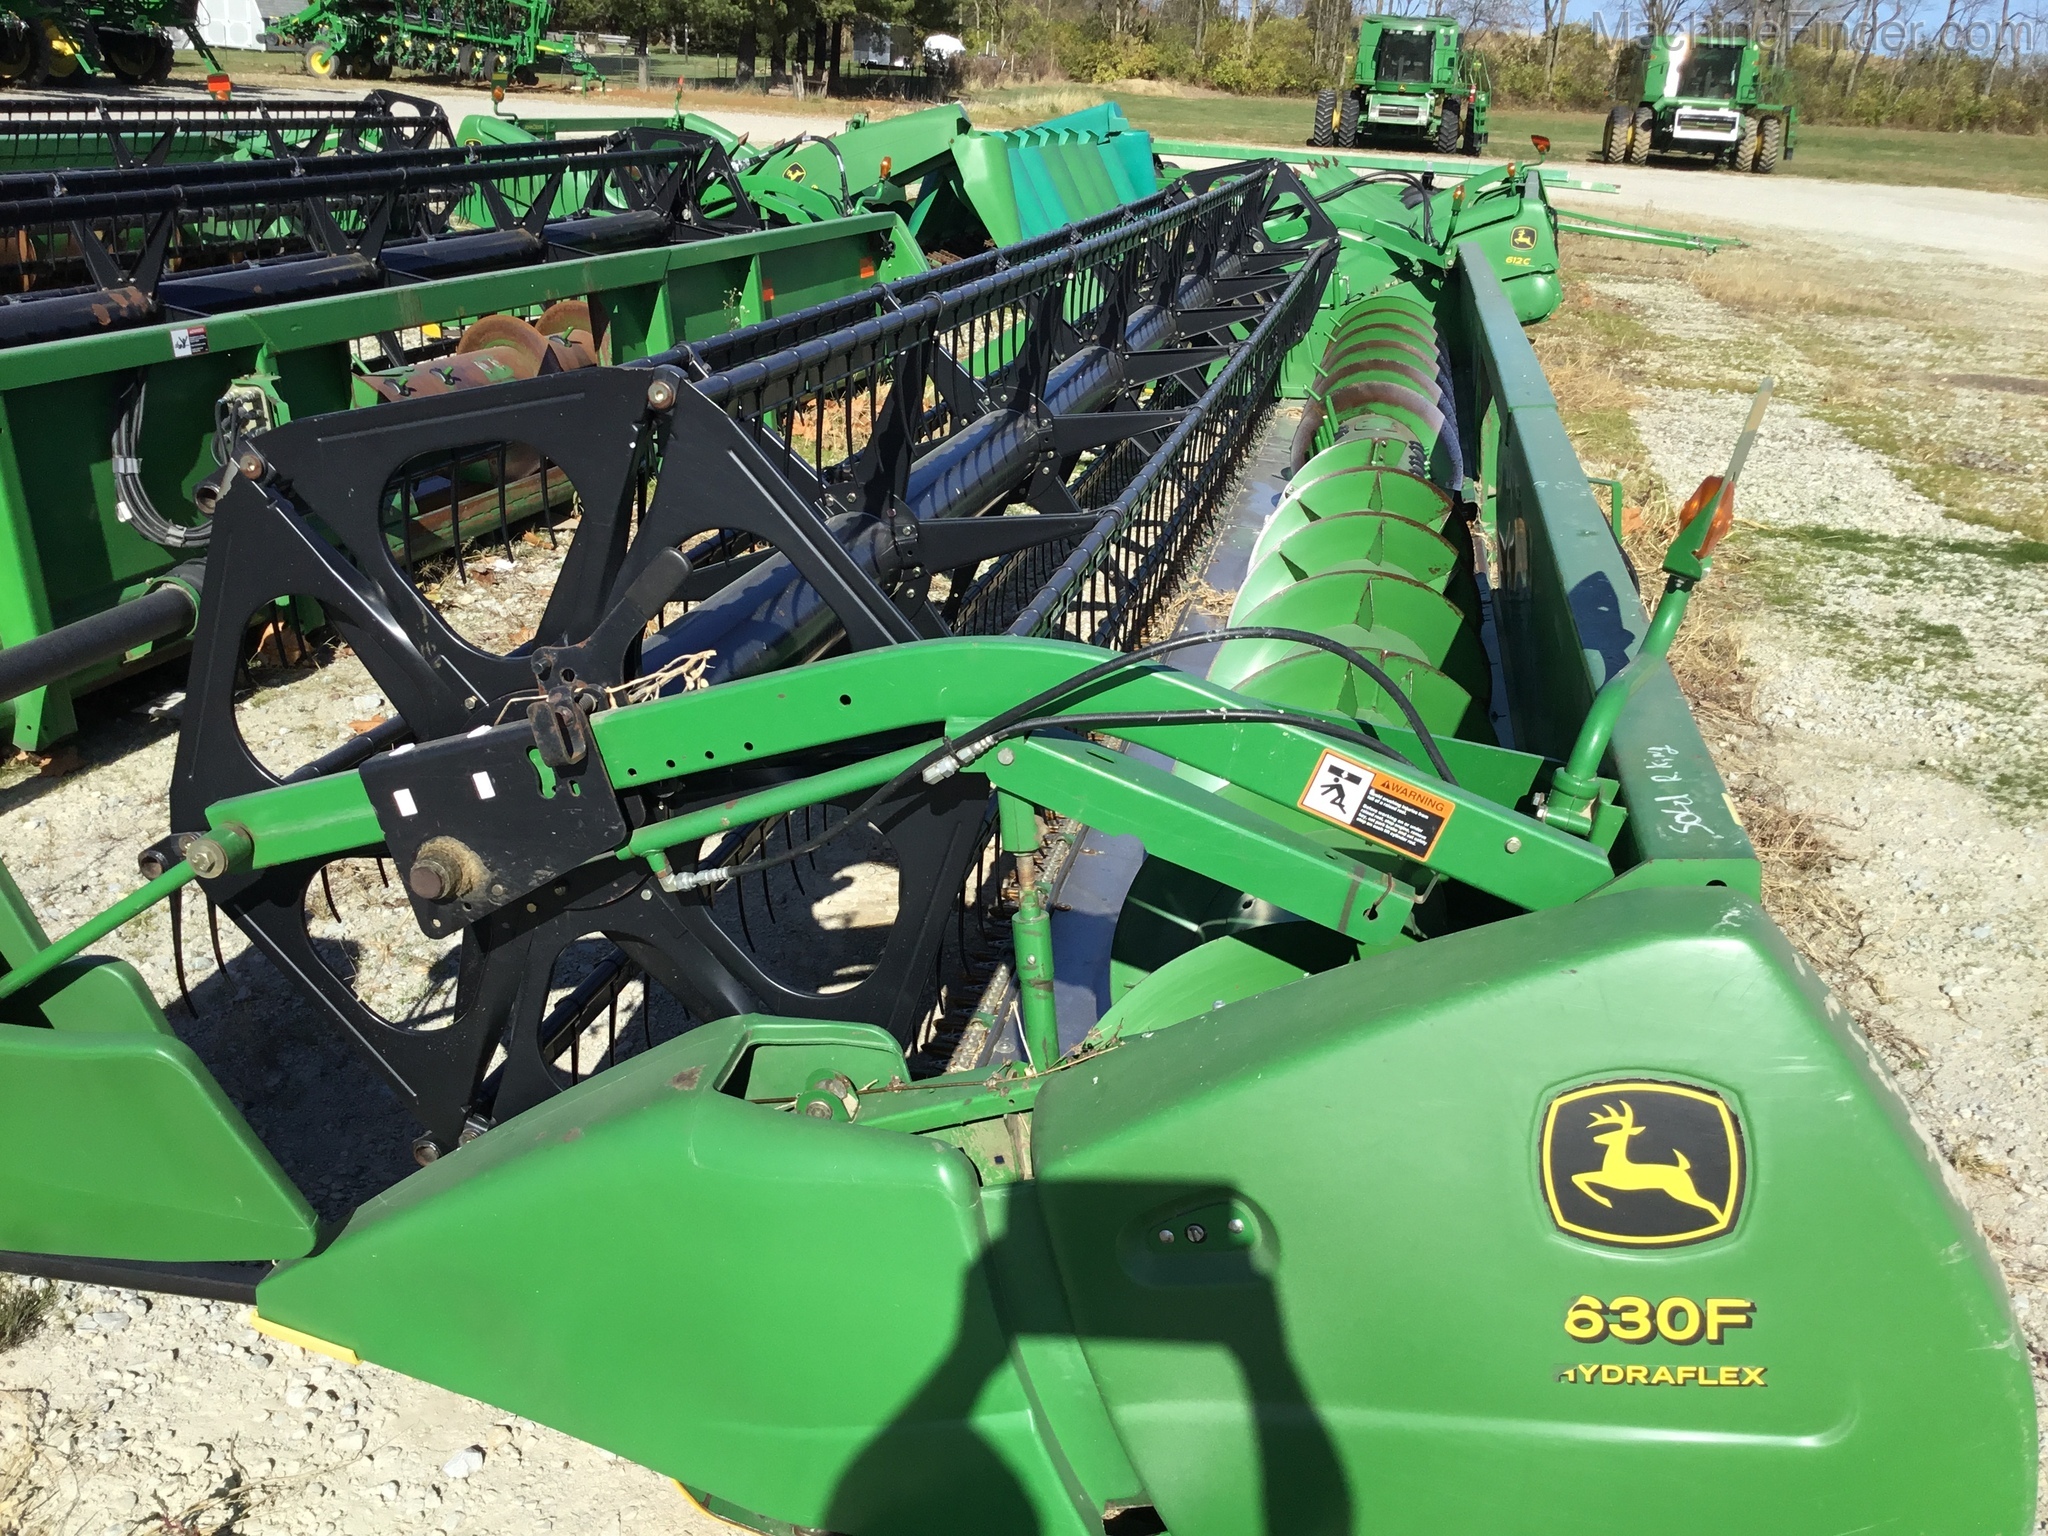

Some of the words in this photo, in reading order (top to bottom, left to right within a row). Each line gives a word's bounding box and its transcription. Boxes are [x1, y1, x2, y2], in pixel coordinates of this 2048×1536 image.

[1505, 255, 1532, 266] 612C
[1391, 783, 1445, 812] WARNING
[1564, 1294, 1757, 1345] 630F
